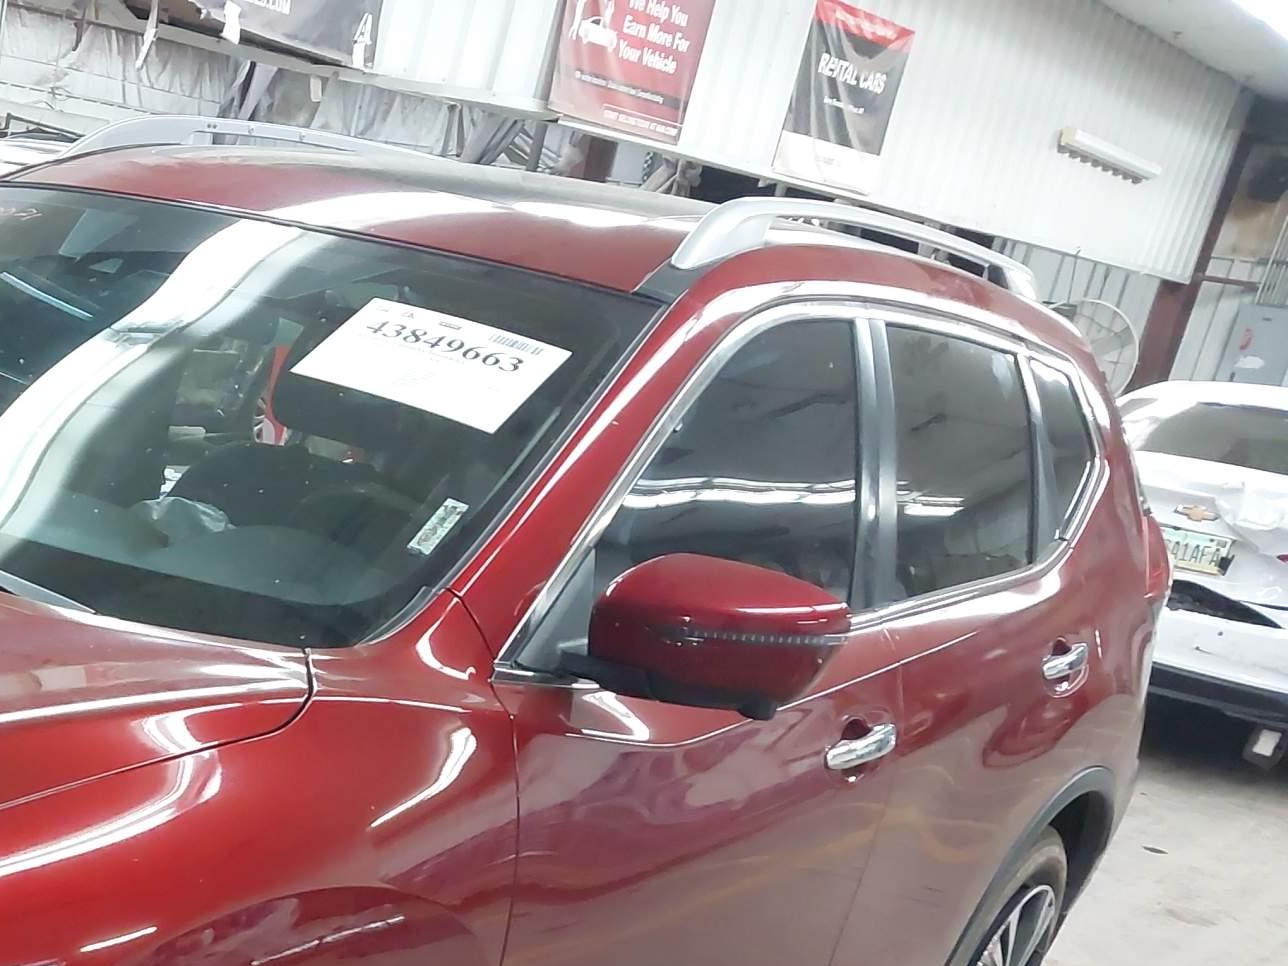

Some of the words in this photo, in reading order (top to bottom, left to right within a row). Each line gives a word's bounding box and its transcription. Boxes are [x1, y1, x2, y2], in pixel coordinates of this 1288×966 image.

[645, 0, 670, 24] Help
[670, 4, 689, 27] You
[622, 14, 647, 39] Earn
[646, 22, 673, 48] More
[672, 31, 691, 53] For
[618, 38, 642, 63] Your
[642, 47, 677, 74] Vehicle
[859, 70, 887, 94] CARS
[366, 320, 524, 372] 43849663
